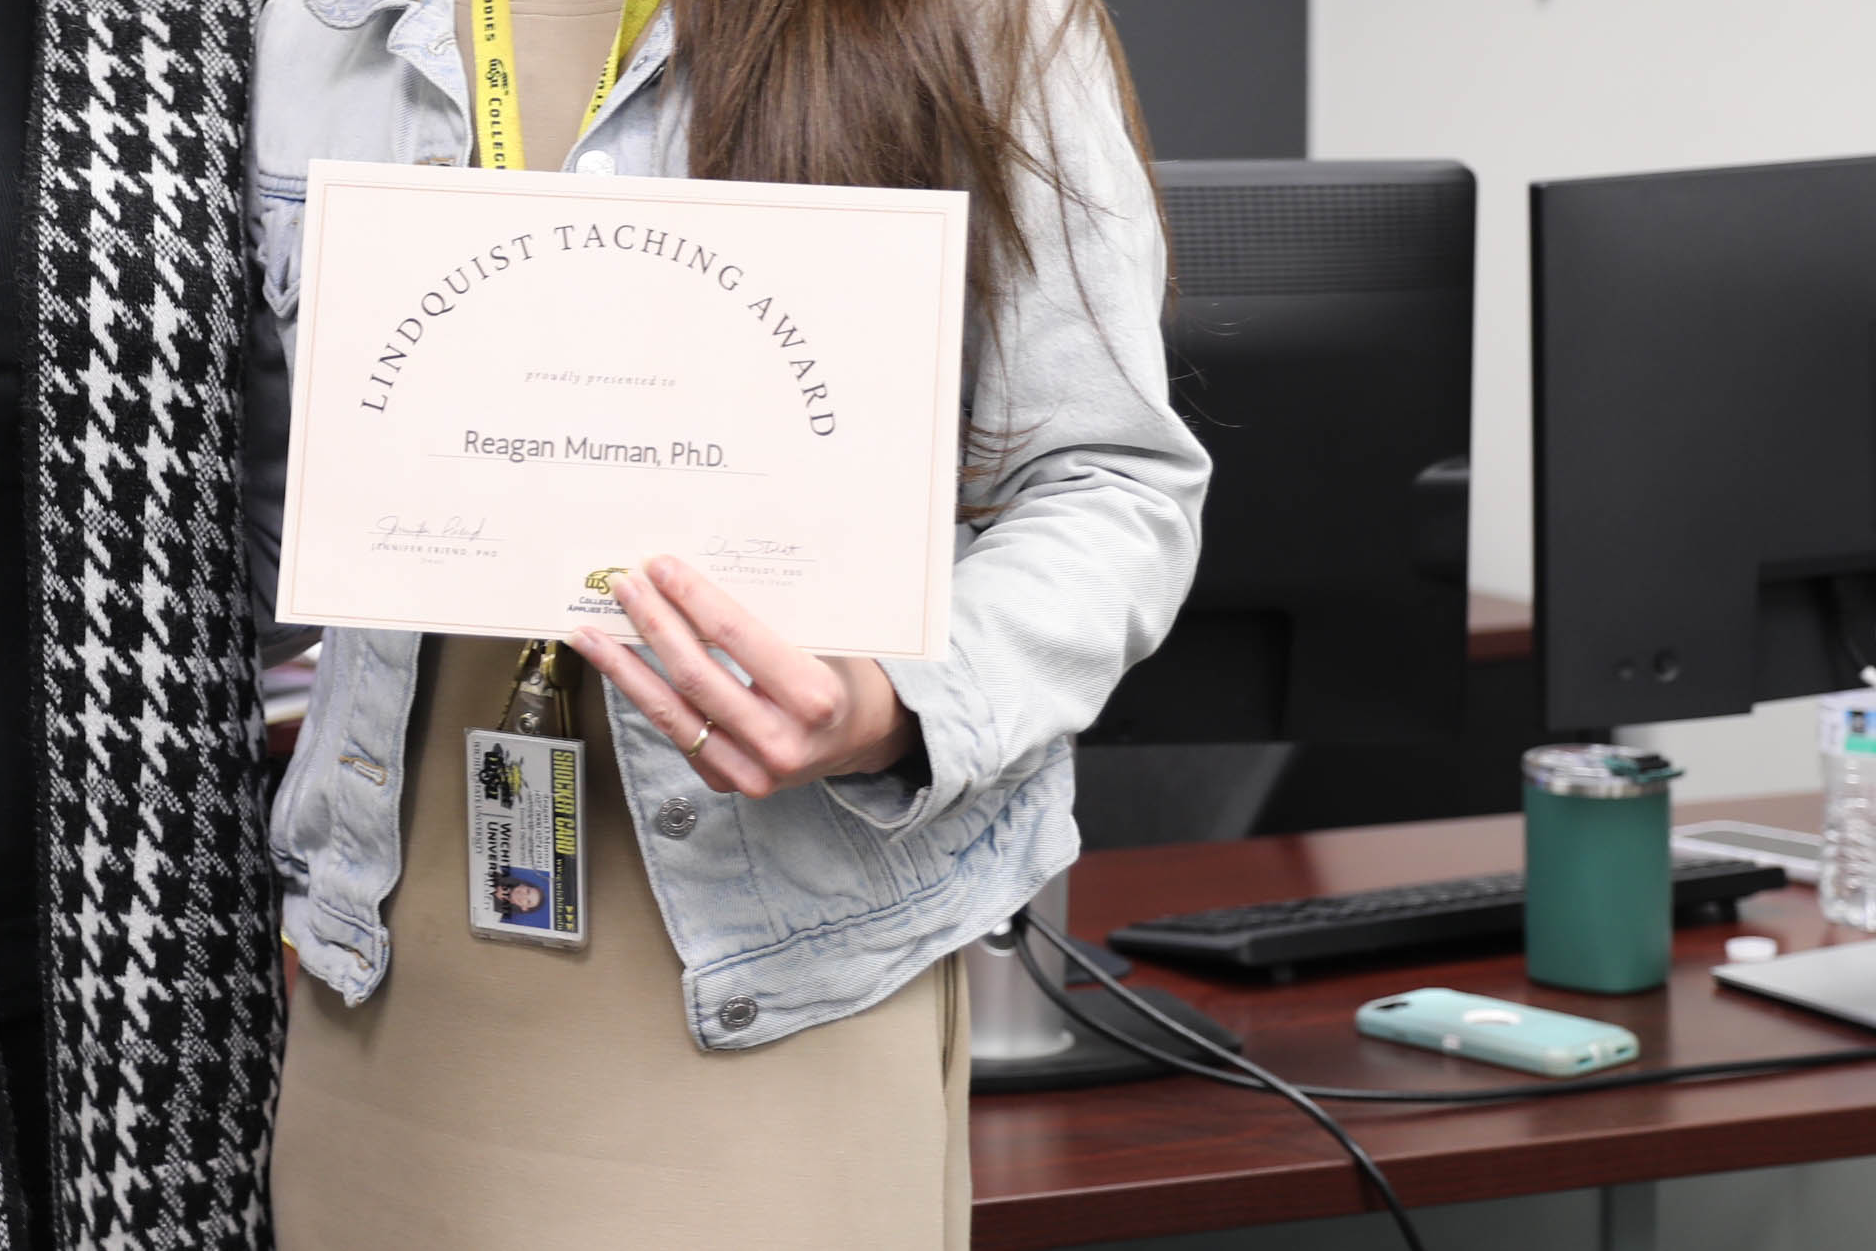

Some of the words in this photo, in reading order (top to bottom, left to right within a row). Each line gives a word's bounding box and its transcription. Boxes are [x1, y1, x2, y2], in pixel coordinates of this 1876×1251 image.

[360, 233, 534, 414] LINDQUIST
[554, 223, 745, 292] TACHING
[747, 296, 837, 437] AWARD
[524, 369, 581, 387] proudly
[586, 373, 658, 388] presented
[661, 377, 677, 387] to
[463, 430, 555, 463] Reagan
[671, 440, 728, 468] Ph.D.
[553, 750, 576, 814] SHOCKER
[500, 823, 513, 878] WICHITA
[555, 816, 576, 855] CARD
